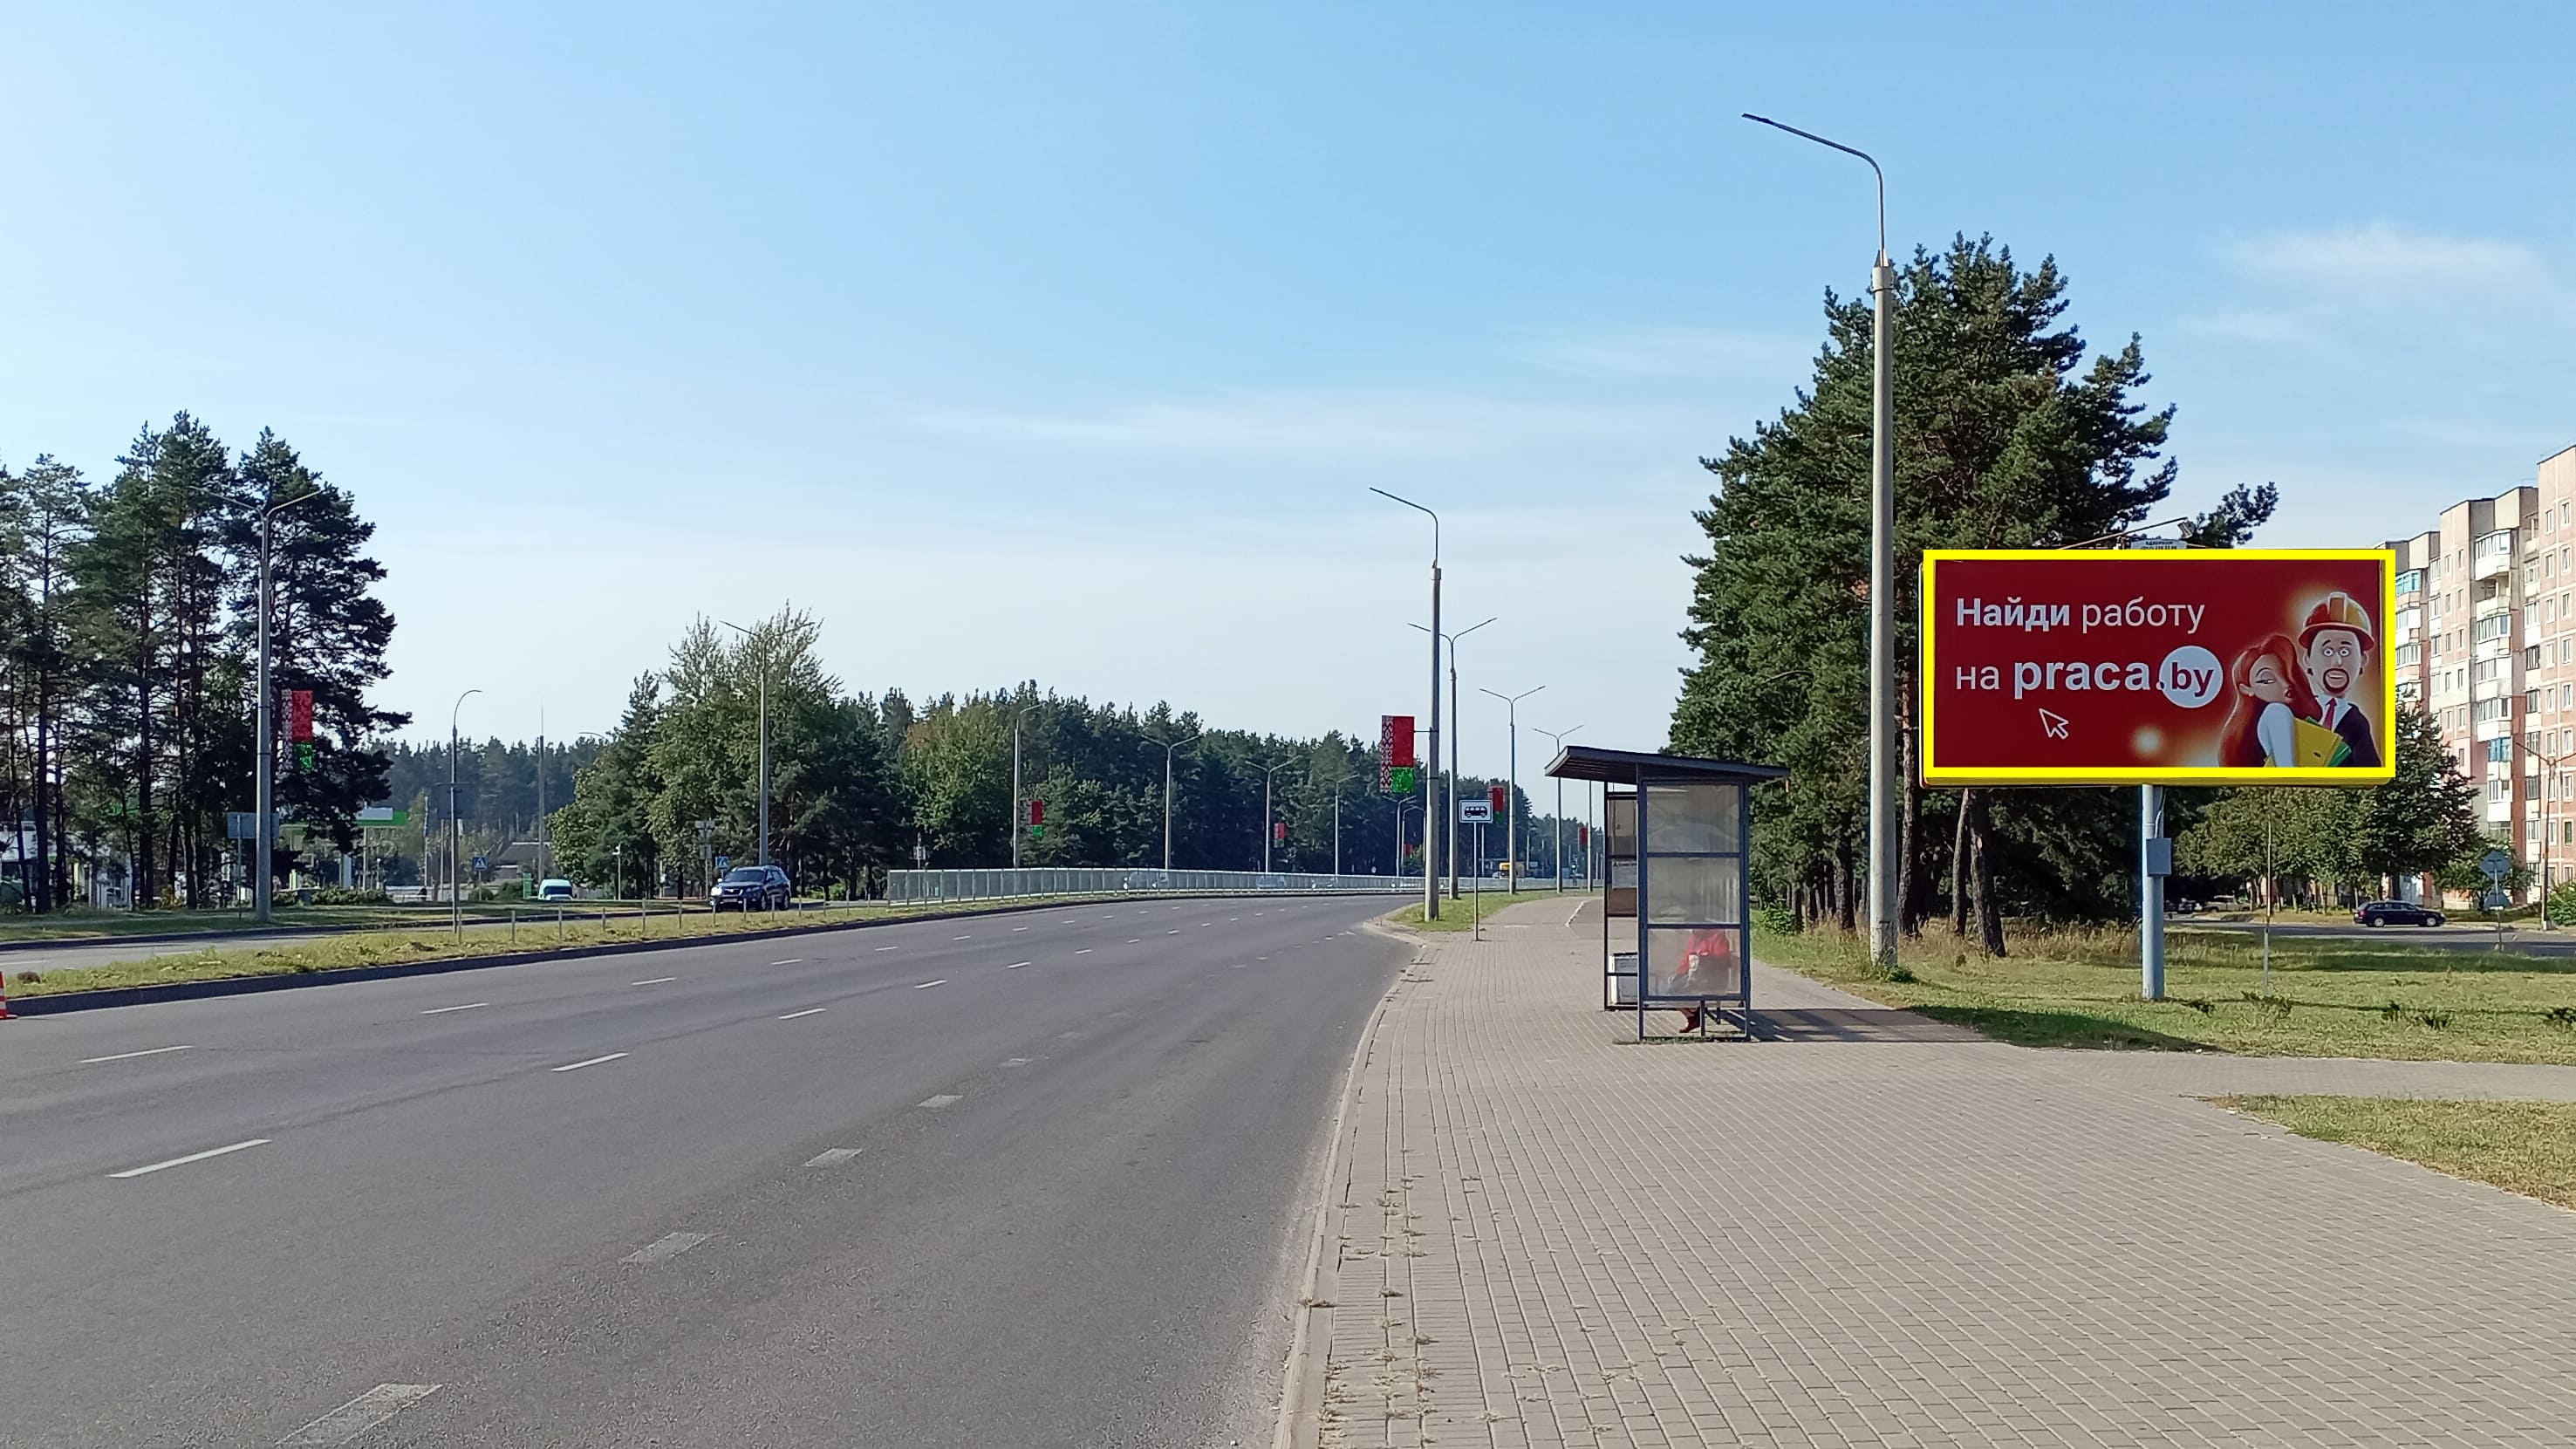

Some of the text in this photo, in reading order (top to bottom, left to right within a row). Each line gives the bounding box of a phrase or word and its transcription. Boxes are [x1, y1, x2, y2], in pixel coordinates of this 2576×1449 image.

[1956, 595, 2205, 635] Найди работу
[1956, 660, 2215, 700] на praca.by
